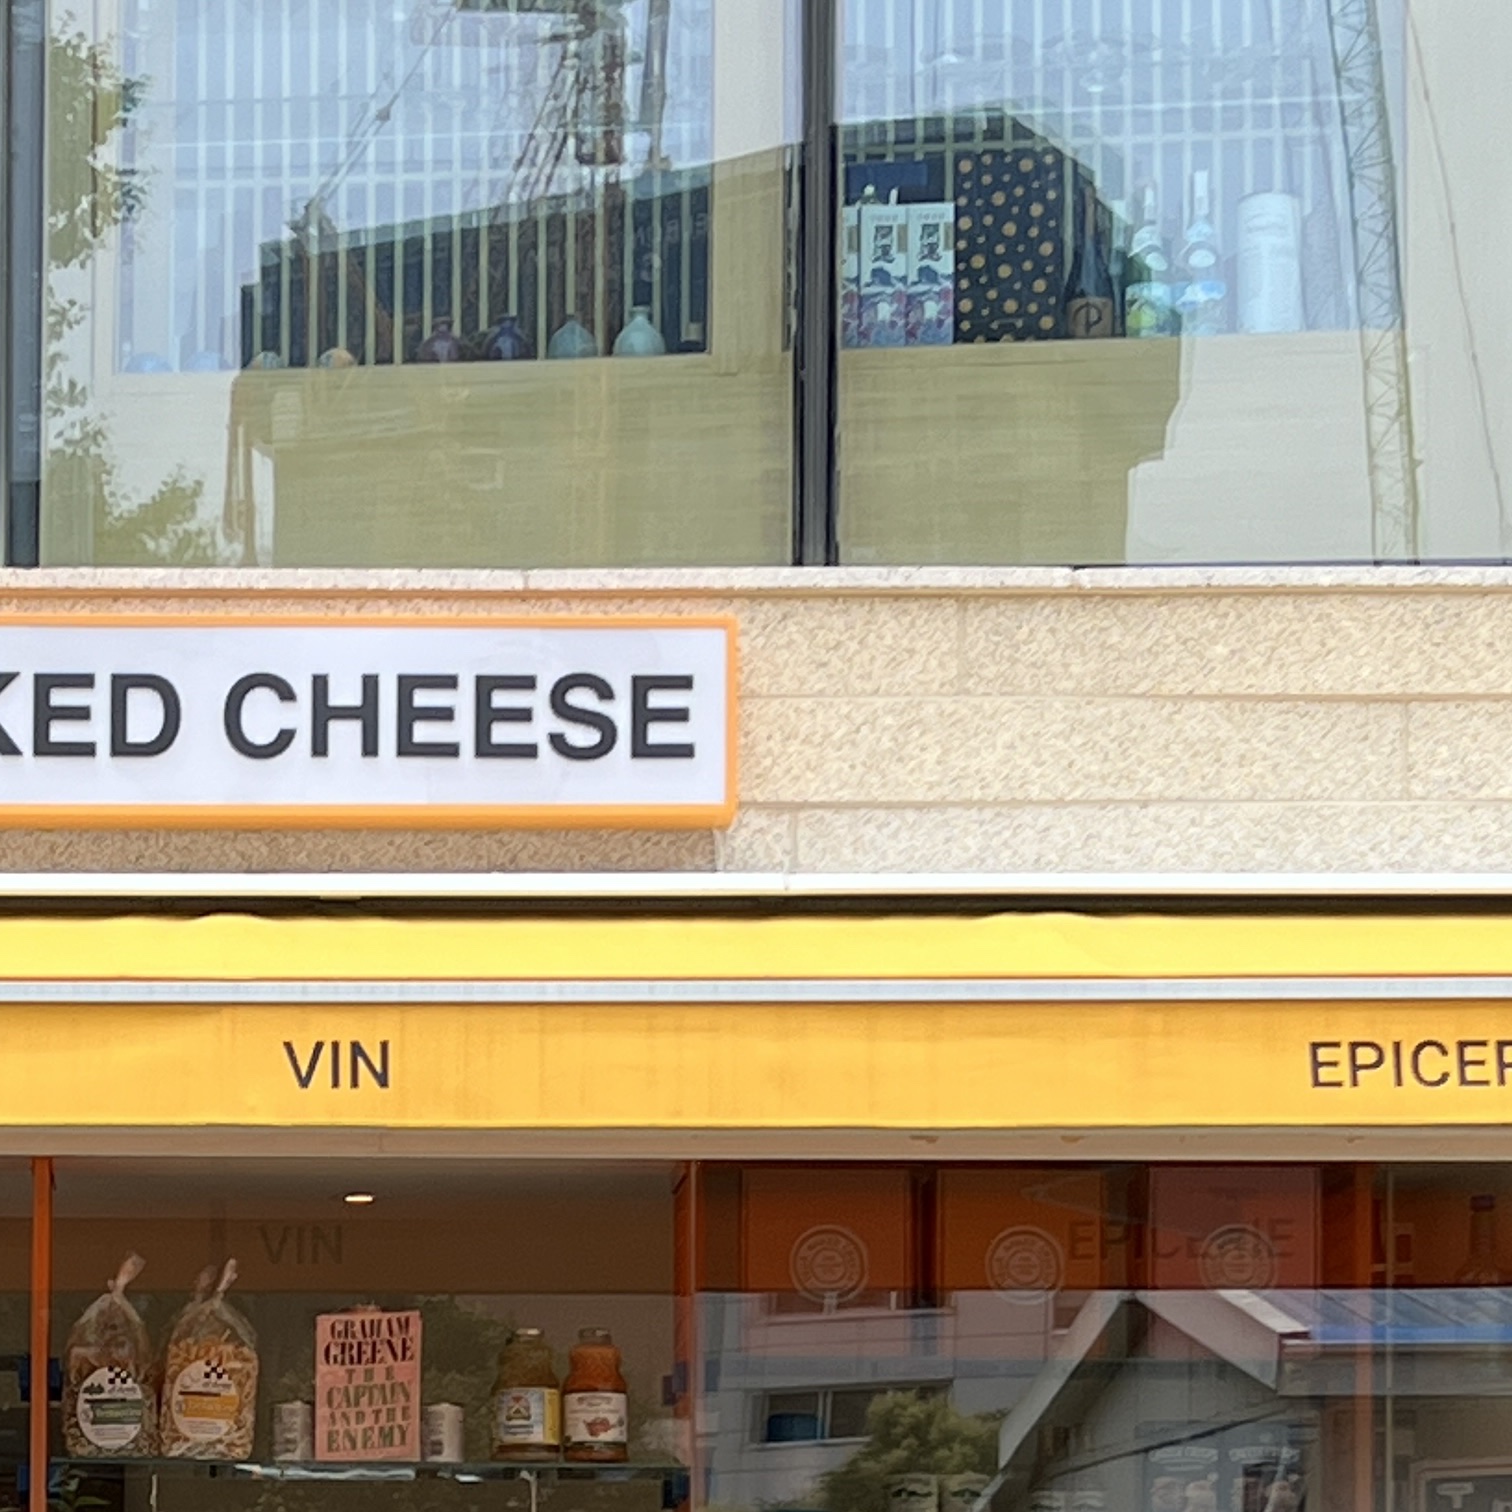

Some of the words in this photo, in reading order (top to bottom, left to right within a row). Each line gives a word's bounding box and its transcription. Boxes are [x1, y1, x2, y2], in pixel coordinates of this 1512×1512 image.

[223, 673, 695, 761] CHEESE
[283, 1040, 389, 1089] VIN
[256, 1224, 343, 1265] VIN
[330, 1315, 411, 1340] GRAHAM
[324, 1337, 415, 1366] GREENE
[345, 1366, 395, 1385] THE
[327, 1381, 411, 1410] CAPTAIN
[329, 1410, 366, 1427] AND
[372, 1406, 411, 1425] THE
[327, 1423, 411, 1453] ENEMY
